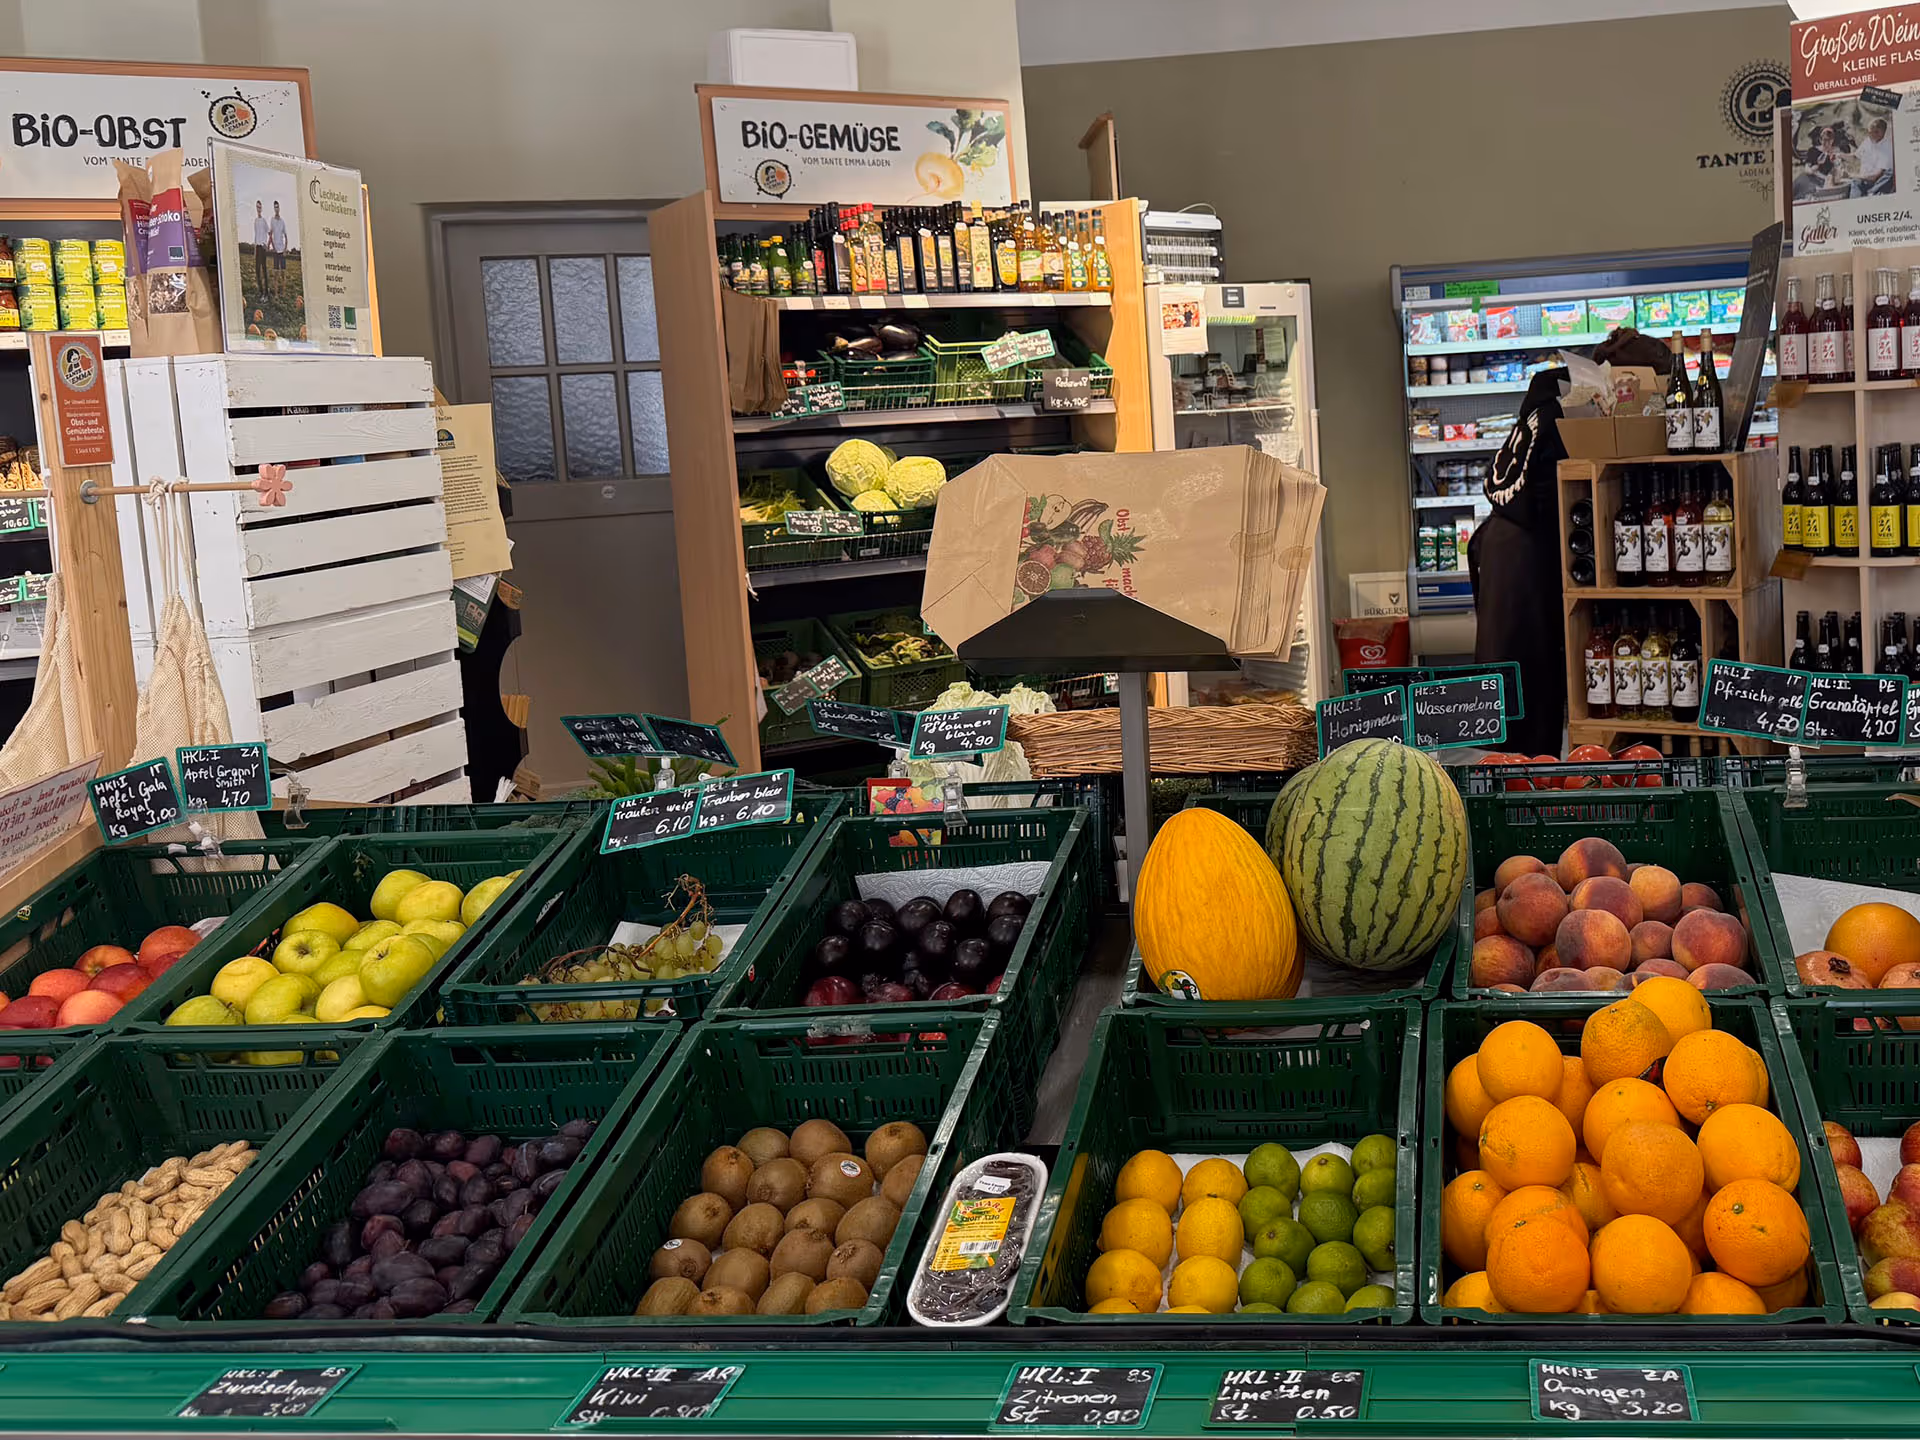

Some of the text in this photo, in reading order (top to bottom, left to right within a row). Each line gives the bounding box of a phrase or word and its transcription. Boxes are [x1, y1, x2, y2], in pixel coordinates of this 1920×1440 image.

[1801, 13, 1920, 77] Großer Wein
[1843, 54, 1887, 72] KLEINE
[1813, 74, 1877, 91] ÜBERALL DABEI.
[228, 119, 249, 132] EMMA
[83, 157, 108, 166] VOM
[181, 157, 210, 167] ADEN
[802, 157, 891, 168] VOM TANTE EMMA LADEN
[1696, 150, 1766, 168] TANTE
[319, 189, 348, 203] Lechtaler
[320, 200, 357, 217] Kürbiskerne
[1857, 210, 1913, 224] UNSER 2/4.
[323, 241, 346, 251] angebaut
[1873, 235, 1885, 244] der
[324, 250, 334, 259] und
[325, 263, 352, 273] verarbeitet
[326, 274, 344, 283] aus der
[65, 368, 82, 380] TANTE
[71, 370, 92, 385] EMMA
[88, 417, 98, 426] und
[1115, 508, 1130, 532] Obst
[1481, 679, 1497, 690] ES
[1786, 675, 1802, 687] IT
[1878, 679, 1896, 693] PE
[1383, 690, 1397, 706] IT
[1714, 679, 1803, 709] Pfirsiche gelb
[988, 707, 1001, 716] IT
[1416, 697, 1502, 715] Wassermelone
[1808, 692, 1900, 720] Granatäpfel
[870, 709, 889, 718] DE
[921, 719, 992, 733] Pflaumen
[1458, 718, 1500, 737] 2,20
[1860, 720, 1896, 739] 4,20
[945, 729, 977, 740] blau
[241, 746, 260, 758] ZA
[920, 736, 994, 754] Kg 4,90
[150, 763, 164, 777] IT
[184, 766, 214, 783] Apfel
[771, 772, 784, 782] IT
[216, 776, 245, 788] Smith
[139, 778, 167, 801] Gala
[683, 788, 695, 798] IT
[702, 785, 783, 808] Trauben blau
[100, 789, 135, 810] Apfel
[220, 790, 250, 808] 4,70
[116, 799, 150, 821] Royal
[145, 807, 177, 825] 3,00
[614, 800, 695, 821] Trauben weiß
[109, 824, 128, 838] Kg
[320, 1367, 346, 1378] ES
[697, 1366, 736, 1381] AR
[1126, 1369, 1152, 1383] ES
[1330, 1372, 1361, 1384] ES
[1641, 1369, 1680, 1382] ZA
[208, 1379, 328, 1403] Zwetschgen
[1013, 1389, 1117, 1405] Zitronen
[1217, 1384, 1330, 1401] Limetten
[1543, 1378, 1647, 1404] Orangen
[1549, 1400, 1684, 1421] Kg 3,20
[1084, 1409, 1140, 1428] 0,90
